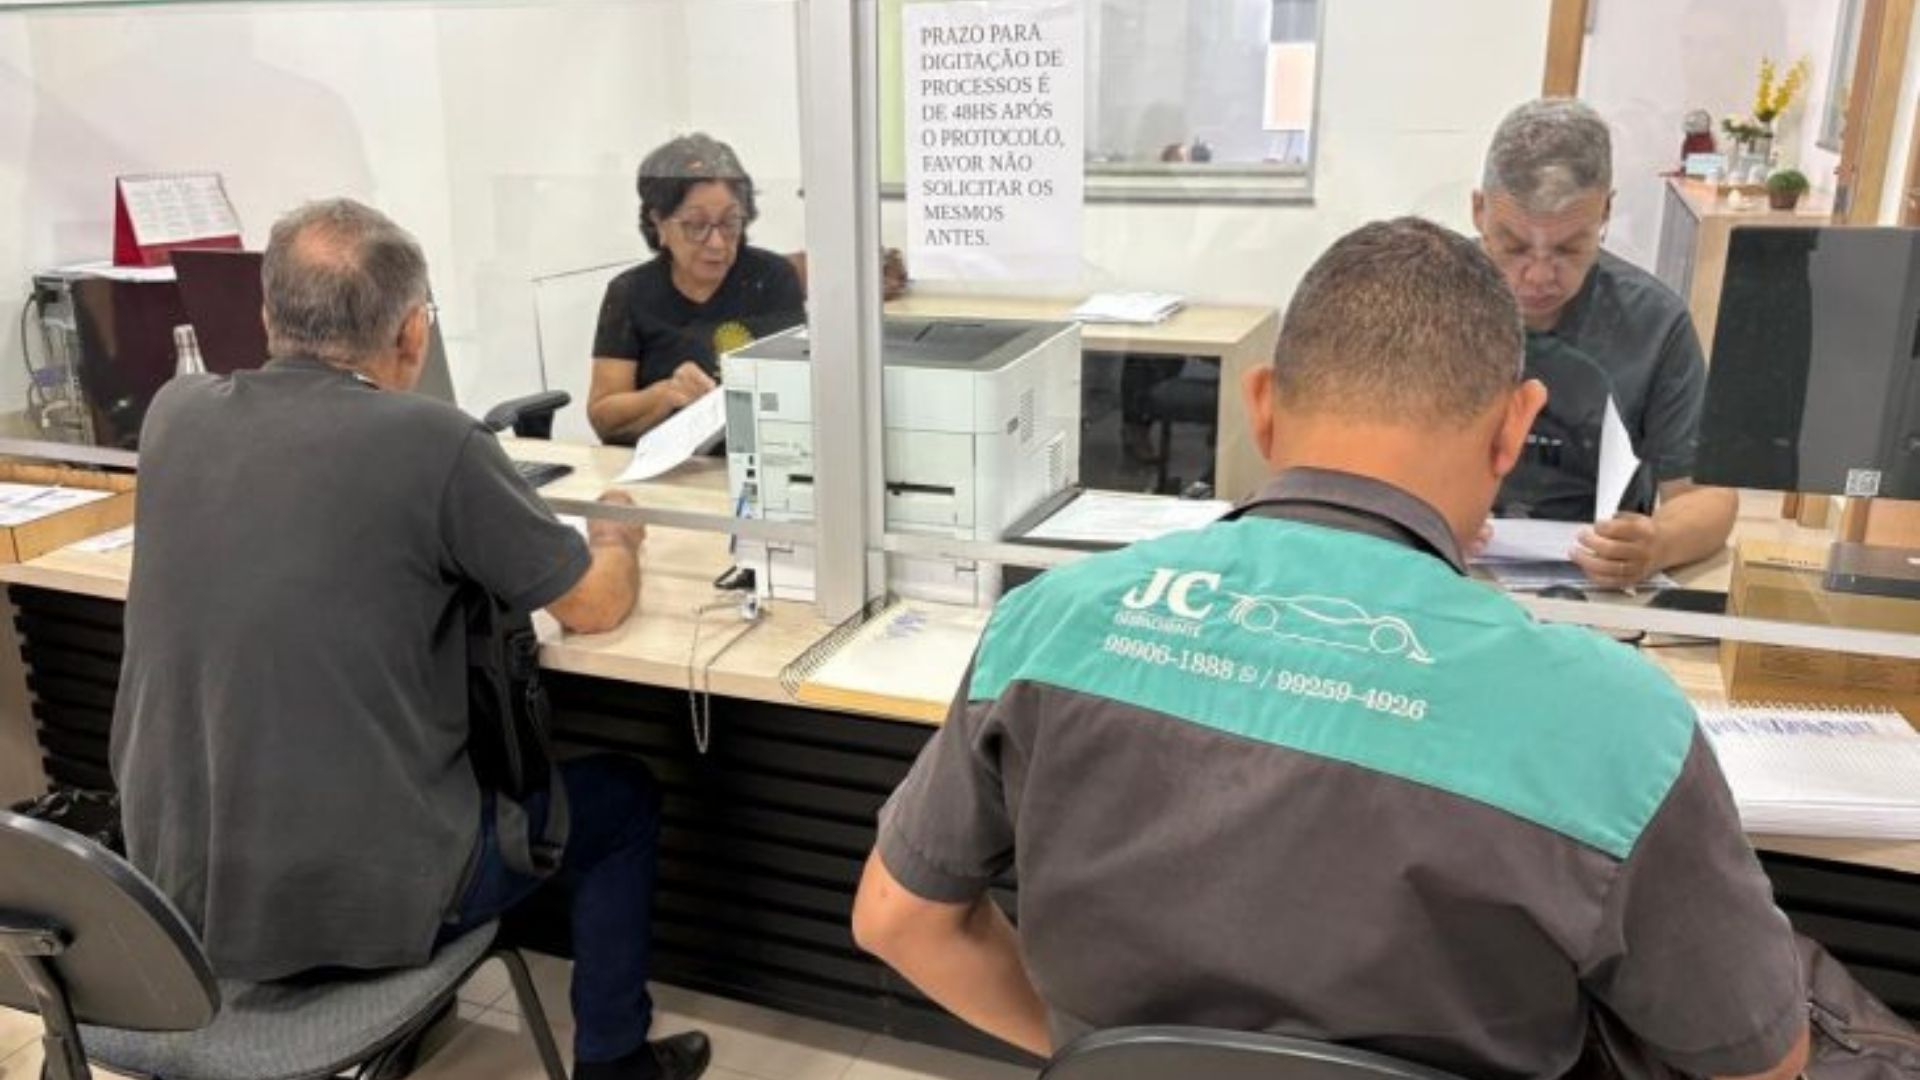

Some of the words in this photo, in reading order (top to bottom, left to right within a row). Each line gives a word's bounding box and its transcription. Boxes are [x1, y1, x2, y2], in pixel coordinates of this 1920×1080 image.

[921, 26, 984, 45] PRAZO
[990, 23, 1042, 43] PARA
[921, 49, 1029, 71] DIGITAÇÃO
[1035, 50, 1063, 68] DE
[921, 77, 1032, 96] PROCESSOS
[1038, 73, 1050, 94] É
[922, 104, 947, 121] DE
[952, 103, 997, 120] 48HS
[1001, 99, 1053, 120] APÓS
[922, 129, 936, 147] O
[941, 127, 1065, 148] PROTOCOLO,
[922, 155, 984, 172] FAVOR
[989, 151, 1032, 172] NÃO
[922, 179, 1022, 197] SOLICITAR
[1028, 179, 1053, 196] OS
[924, 205, 1004, 221] MESMOS
[925, 228, 989, 246] ANTES.
[1122, 568, 1221, 619] JC
[1104, 634, 1234, 680] 99906-1888
[1277, 670, 1428, 720] 99259-4926
